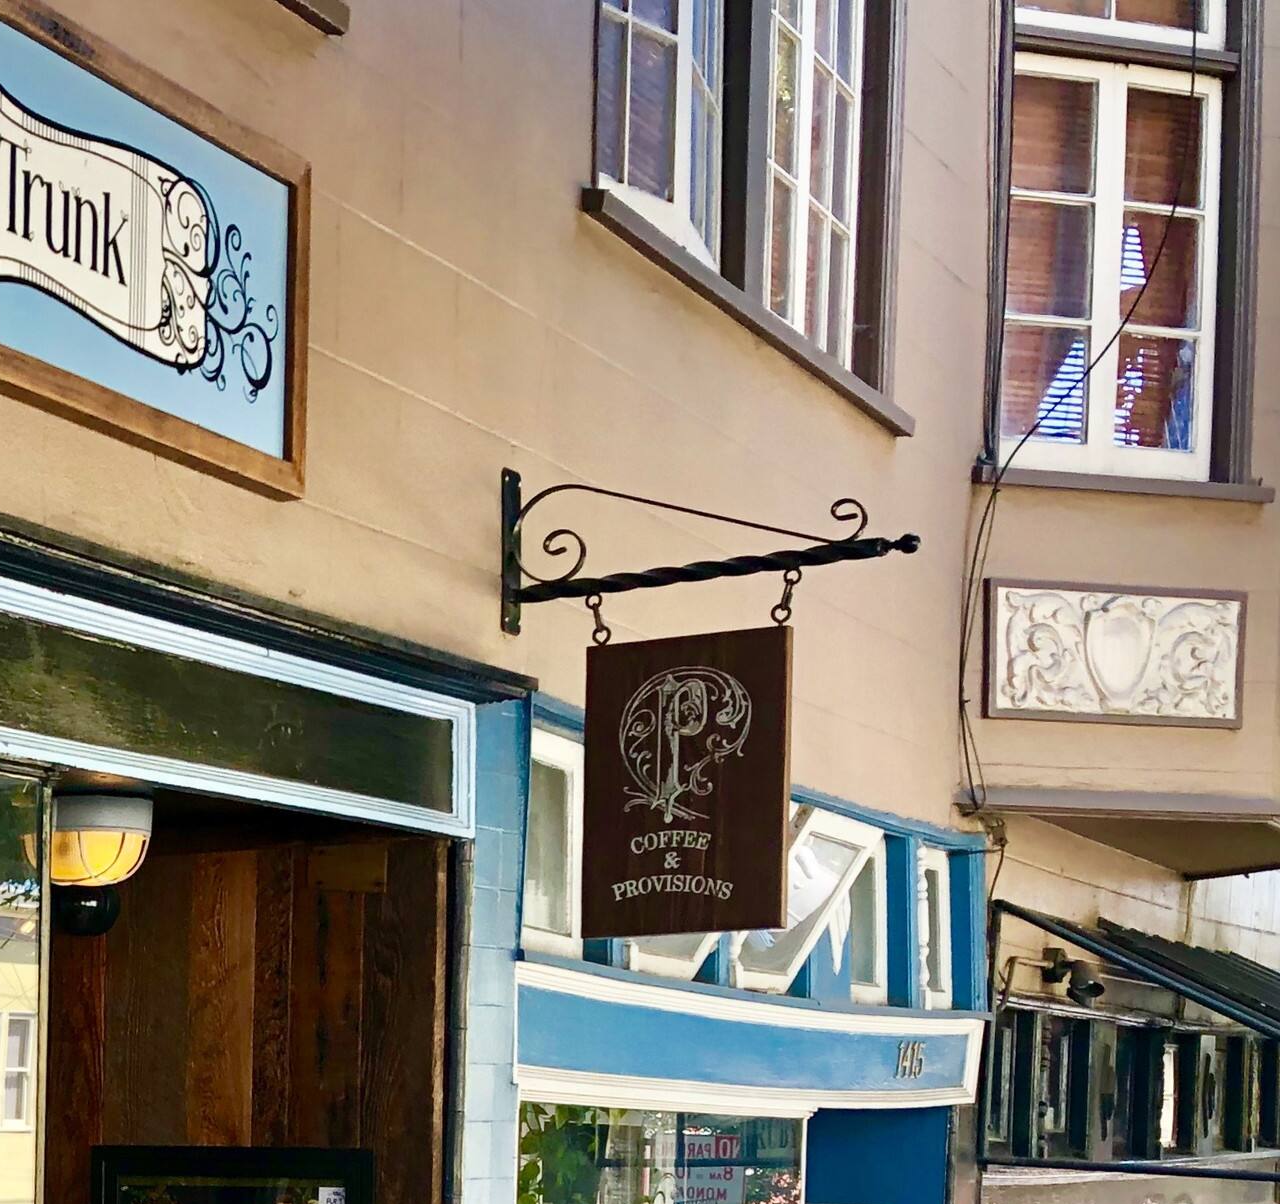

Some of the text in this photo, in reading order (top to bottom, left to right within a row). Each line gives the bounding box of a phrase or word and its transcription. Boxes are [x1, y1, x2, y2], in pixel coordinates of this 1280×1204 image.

[0, 134, 128, 288] Trunk
[630, 829, 712, 855] COFFEE
[663, 851, 681, 870] &
[611, 874, 734, 901] PROVISIONS
[894, 1040, 927, 1079] 1415
